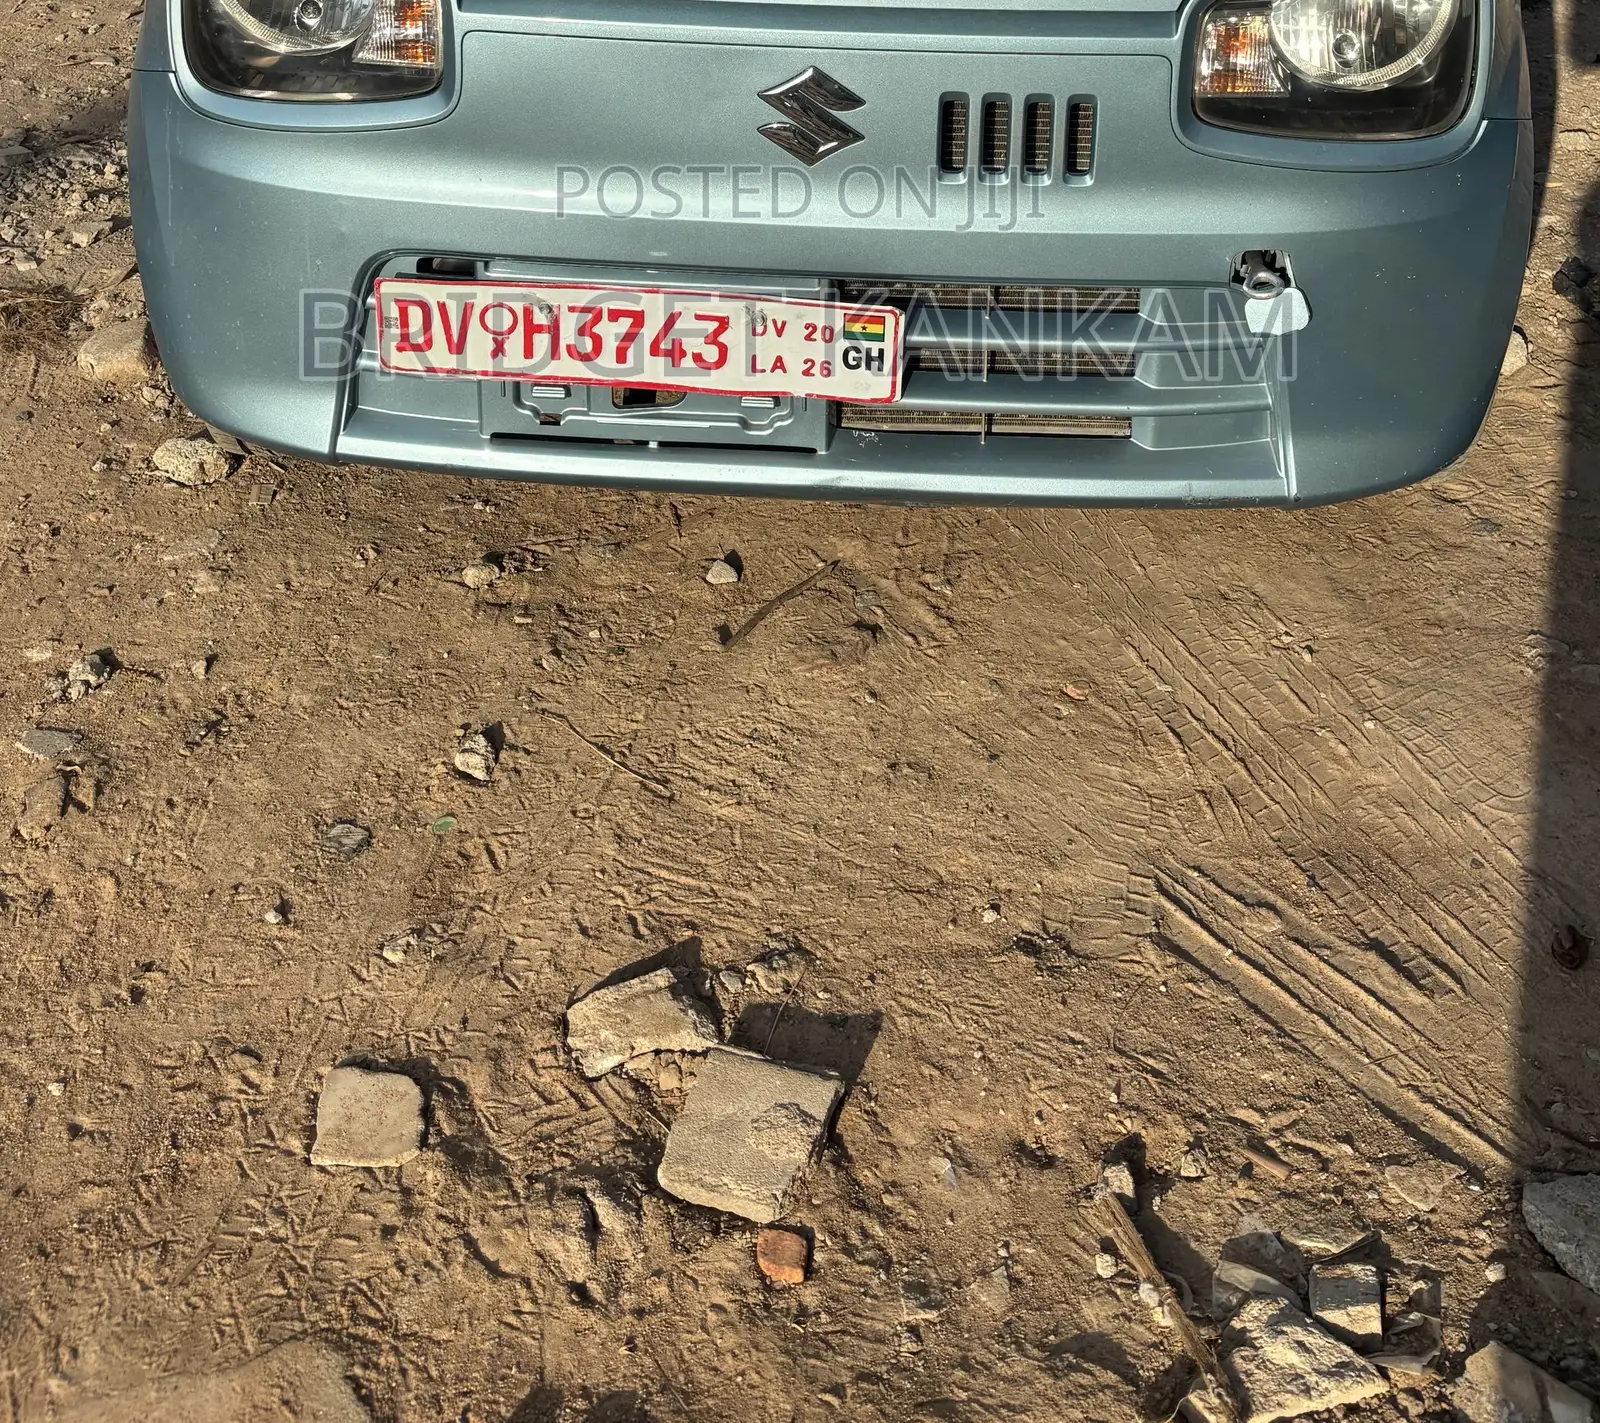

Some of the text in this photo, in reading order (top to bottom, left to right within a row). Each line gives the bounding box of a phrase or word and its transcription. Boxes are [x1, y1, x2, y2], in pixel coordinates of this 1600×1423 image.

[803, 322, 835, 344] 20
[750, 354, 833, 379] LA 26
[842, 345, 885, 372] GH
